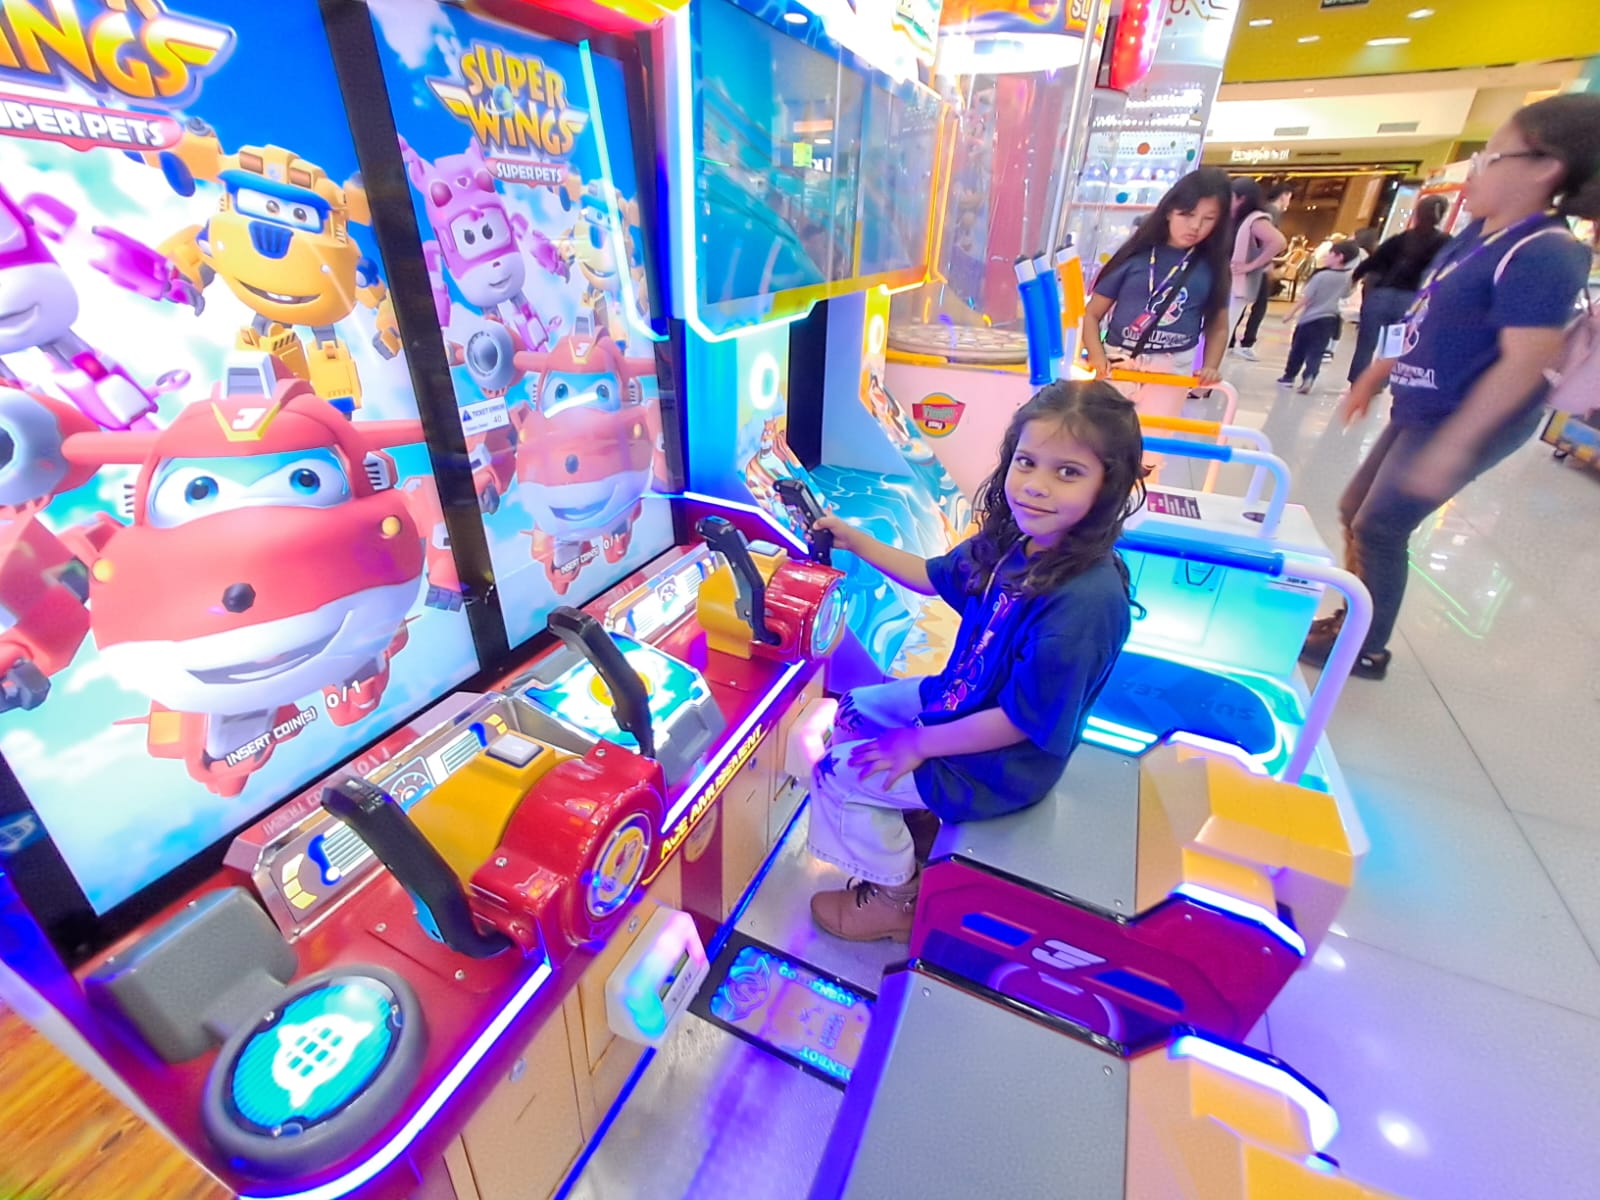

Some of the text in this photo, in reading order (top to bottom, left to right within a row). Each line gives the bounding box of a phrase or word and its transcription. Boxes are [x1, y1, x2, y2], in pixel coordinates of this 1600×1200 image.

[460, 44, 566, 111] SUPER
[445, 90, 588, 155] WINGS
[226, 733, 271, 767] INSERT
[273, 706, 317, 740] COIN(S)
[689, 723, 762, 823] AMUSEMENT
